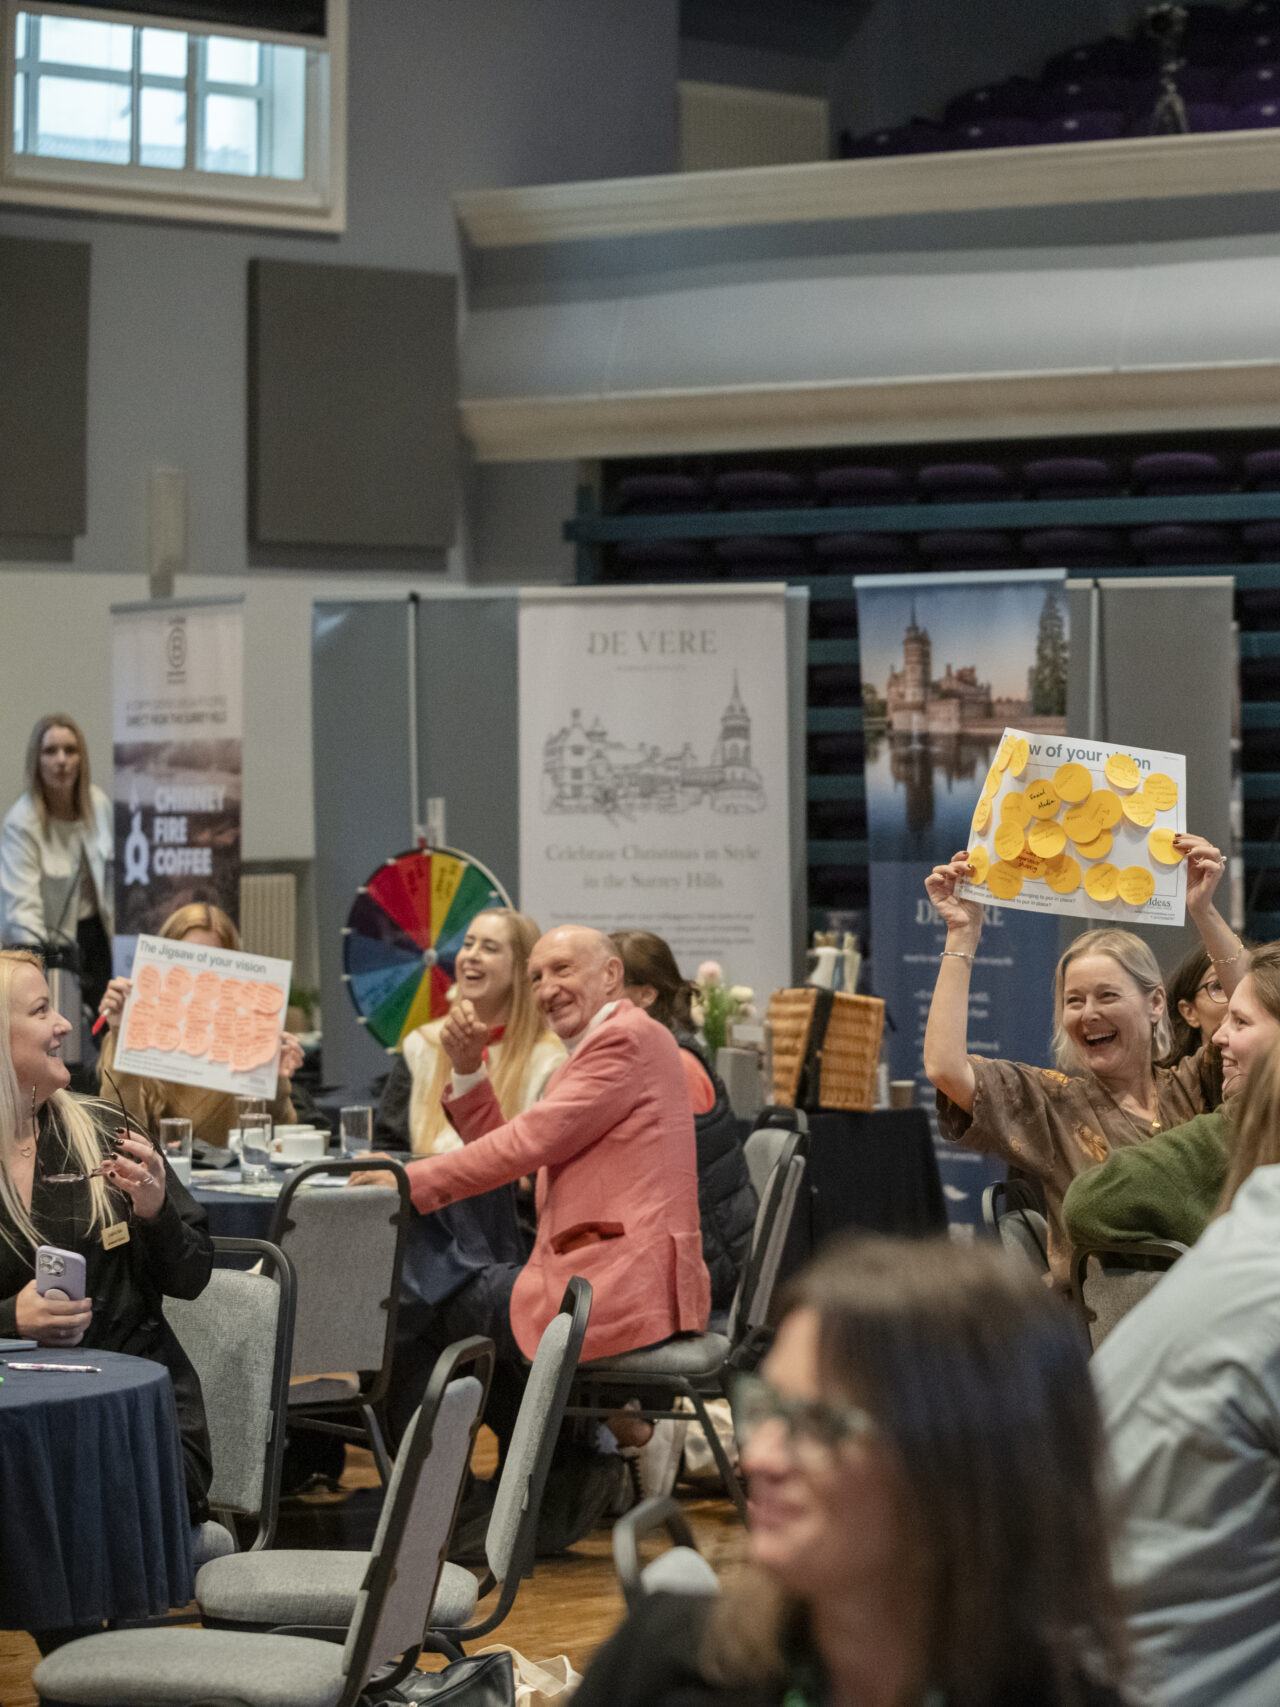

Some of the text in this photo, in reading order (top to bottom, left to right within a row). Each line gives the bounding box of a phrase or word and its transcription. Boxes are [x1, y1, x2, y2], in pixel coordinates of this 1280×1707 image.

[587, 630, 717, 655] DE VERE
[1045, 743, 1062, 758] of
[1066, 747, 1102, 762] your
[155, 784, 226, 812] CHIMNEY
[153, 816, 188, 845] FIRE
[153, 847, 213, 876] COFFEE
[140, 939, 267, 974] The Jigsaw of your vision
